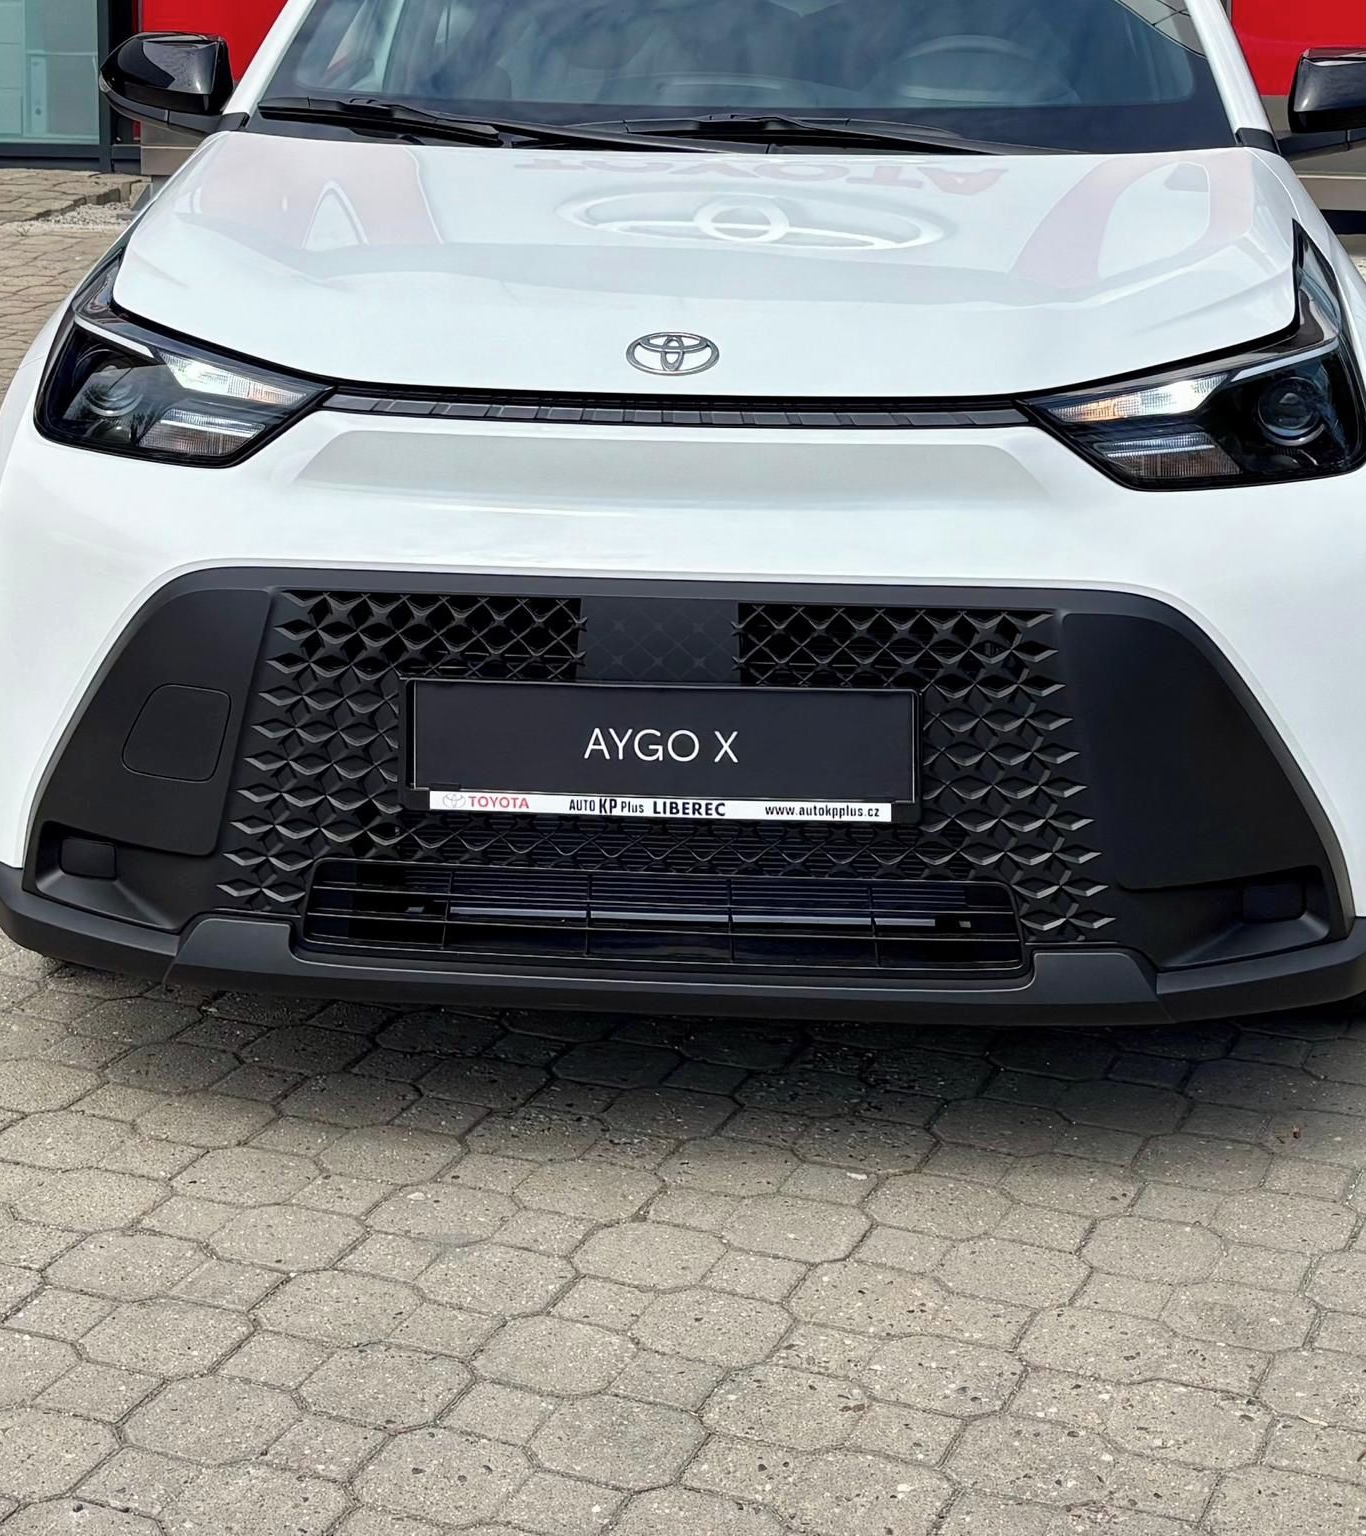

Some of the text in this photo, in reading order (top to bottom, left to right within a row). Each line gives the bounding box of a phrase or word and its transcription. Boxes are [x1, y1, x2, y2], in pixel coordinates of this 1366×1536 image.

[584, 727, 739, 763] AYGO X
[468, 795, 880, 819] TOYOTA AUTO KP Plus LIBEREC www.autokpplus.cz
